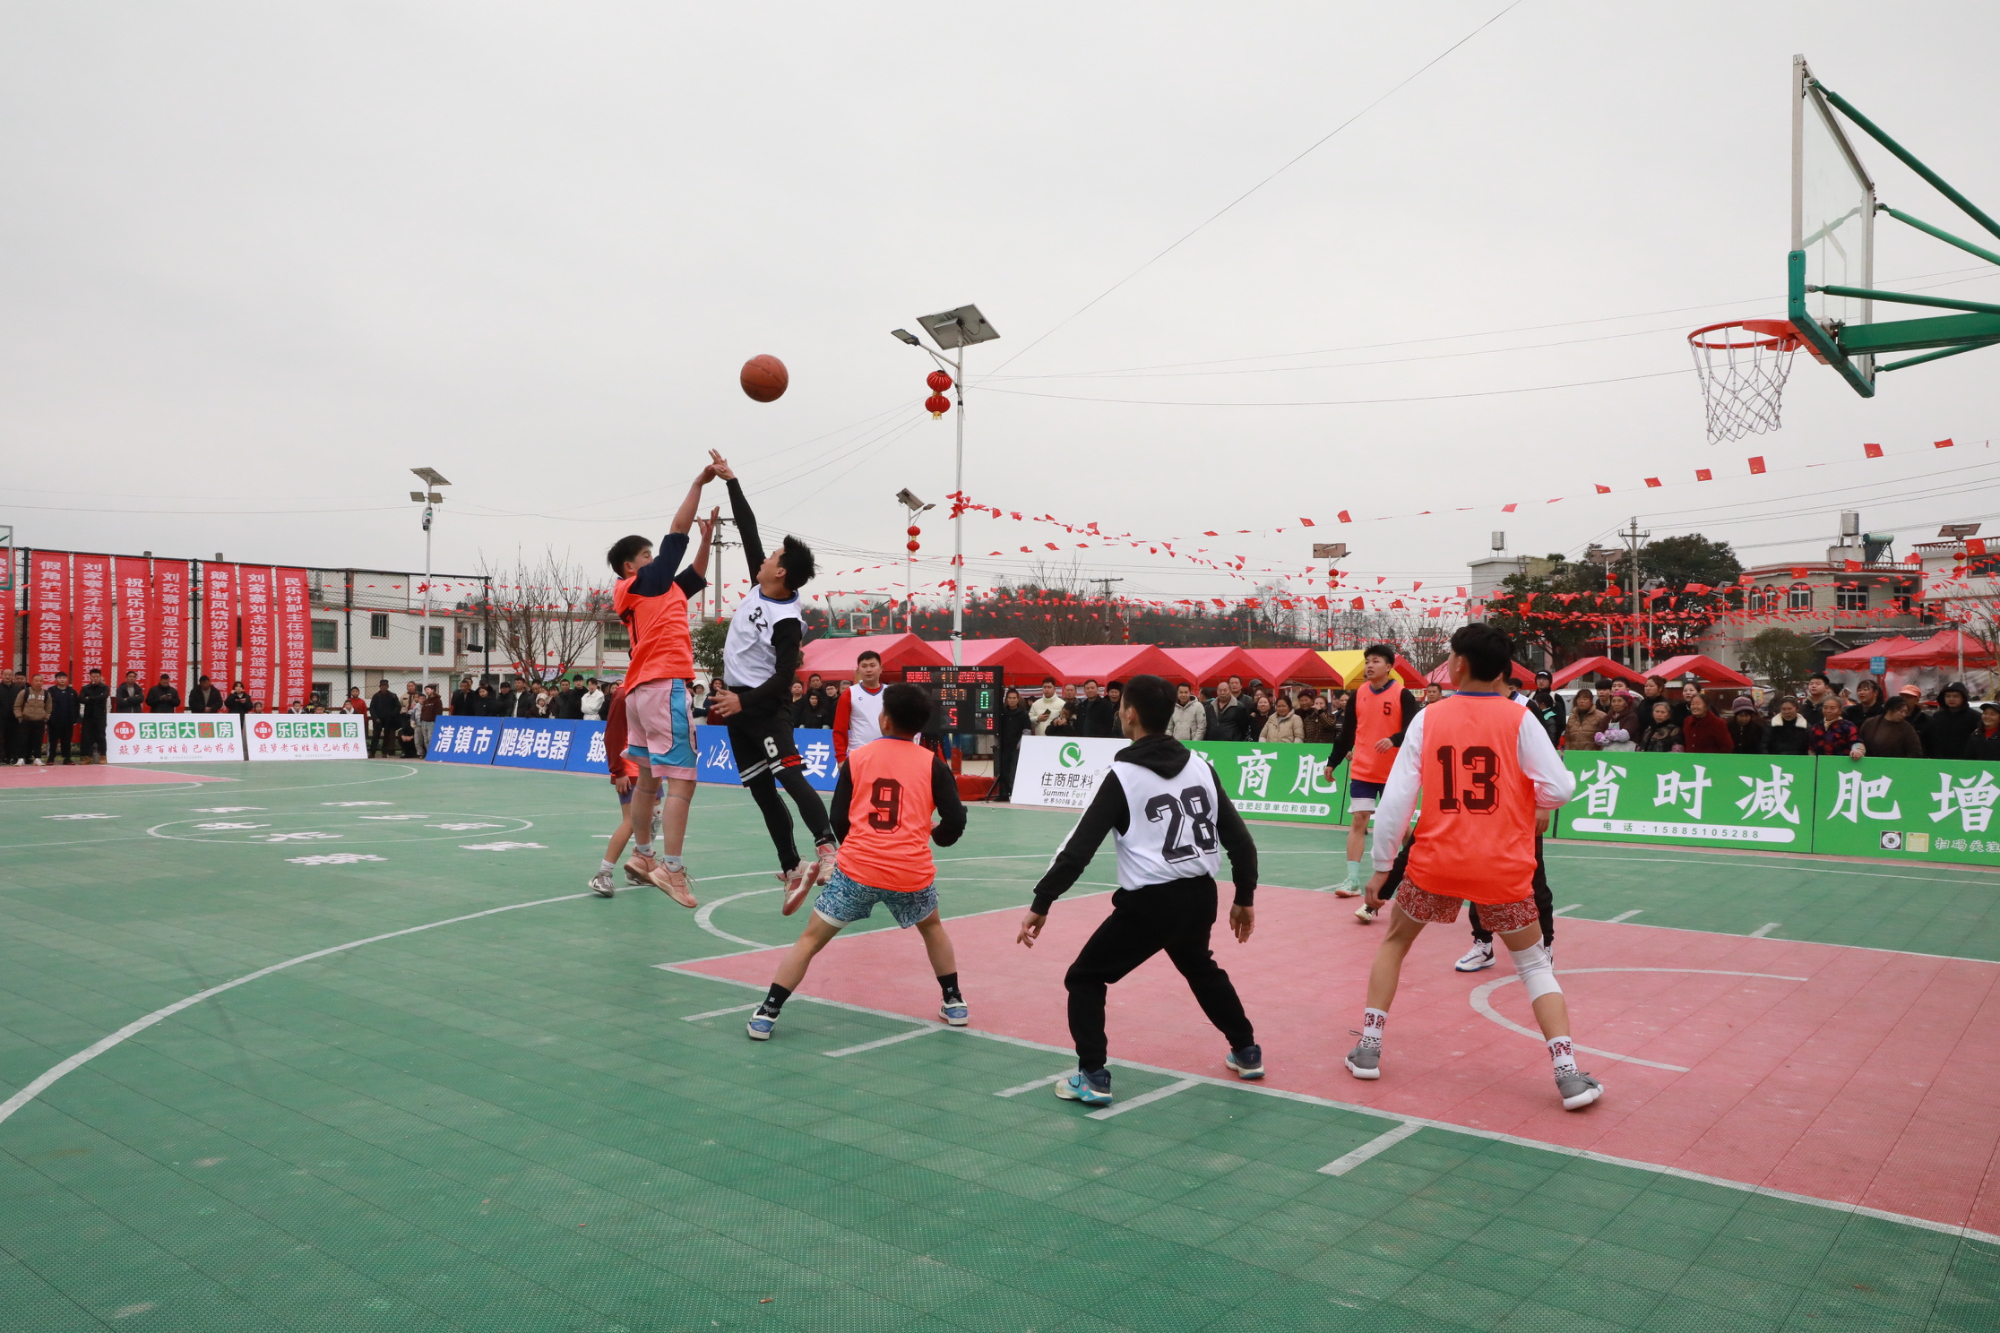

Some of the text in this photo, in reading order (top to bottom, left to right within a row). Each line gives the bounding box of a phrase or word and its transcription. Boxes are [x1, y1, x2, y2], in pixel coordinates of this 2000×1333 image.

[748, 606, 769, 633] 32
[980, 691, 989, 709] 0
[1383, 701, 1392, 716] 5
[948, 708, 958, 726] 5
[140, 722, 233, 739] 乐乐大药房
[276, 722, 358, 739] 乐乐大药房
[434, 725, 493, 755] 清镇市
[497, 727, 571, 761] 鹏缘电器
[763, 736, 779, 758] 6
[1040, 771, 1094, 789] 住商肥料
[1198, 749, 1337, 798] 商肥
[1437, 745, 1501, 815] 13
[1042, 788, 1070, 798] Summit
[868, 777, 904, 834] 9
[1233, 802, 1326, 815] 合肥起草单位和倡导者
[1145, 785, 1218, 864] 28
